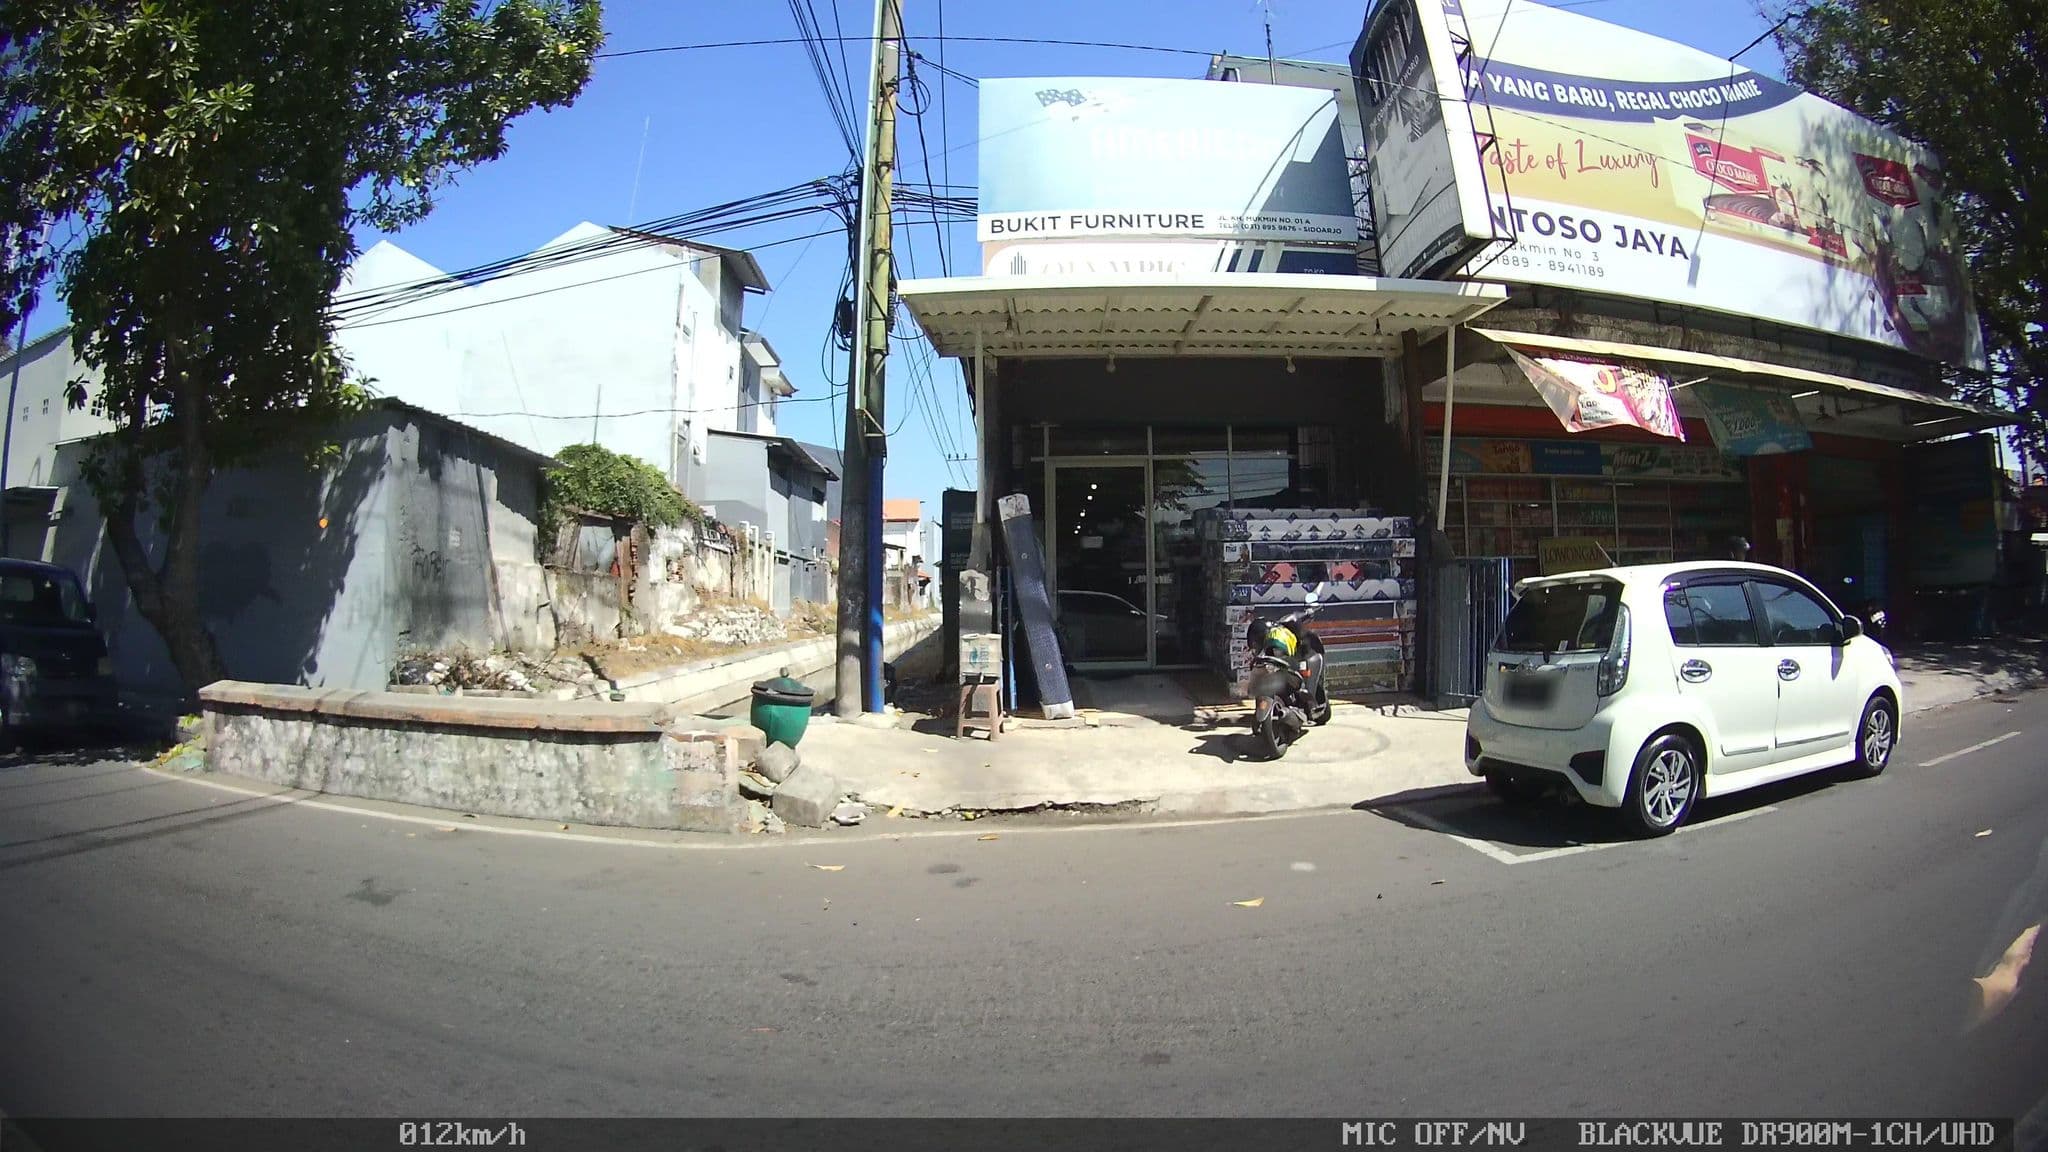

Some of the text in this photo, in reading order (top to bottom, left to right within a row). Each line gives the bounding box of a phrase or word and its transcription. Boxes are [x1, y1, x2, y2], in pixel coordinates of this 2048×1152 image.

[1487, 73, 1549, 102] YANG
[1550, 84, 1616, 113] BARU,
[1614, 90, 1670, 111] REGAL
[1672, 85, 1722, 110] CHOCO
[1723, 78, 1763, 103] MARIE
[1546, 142, 1568, 180] of
[1574, 138, 1660, 189] Luxury
[990, 214, 1205, 234] BUKIT FURNITURE
[1303, 226, 1342, 235] SIDOARJO
[1613, 224, 1690, 261] JAYA
[1563, 249, 1582, 258] No
[1592, 251, 1600, 262] 3
[1548, 260, 1605, 278] 8941189
